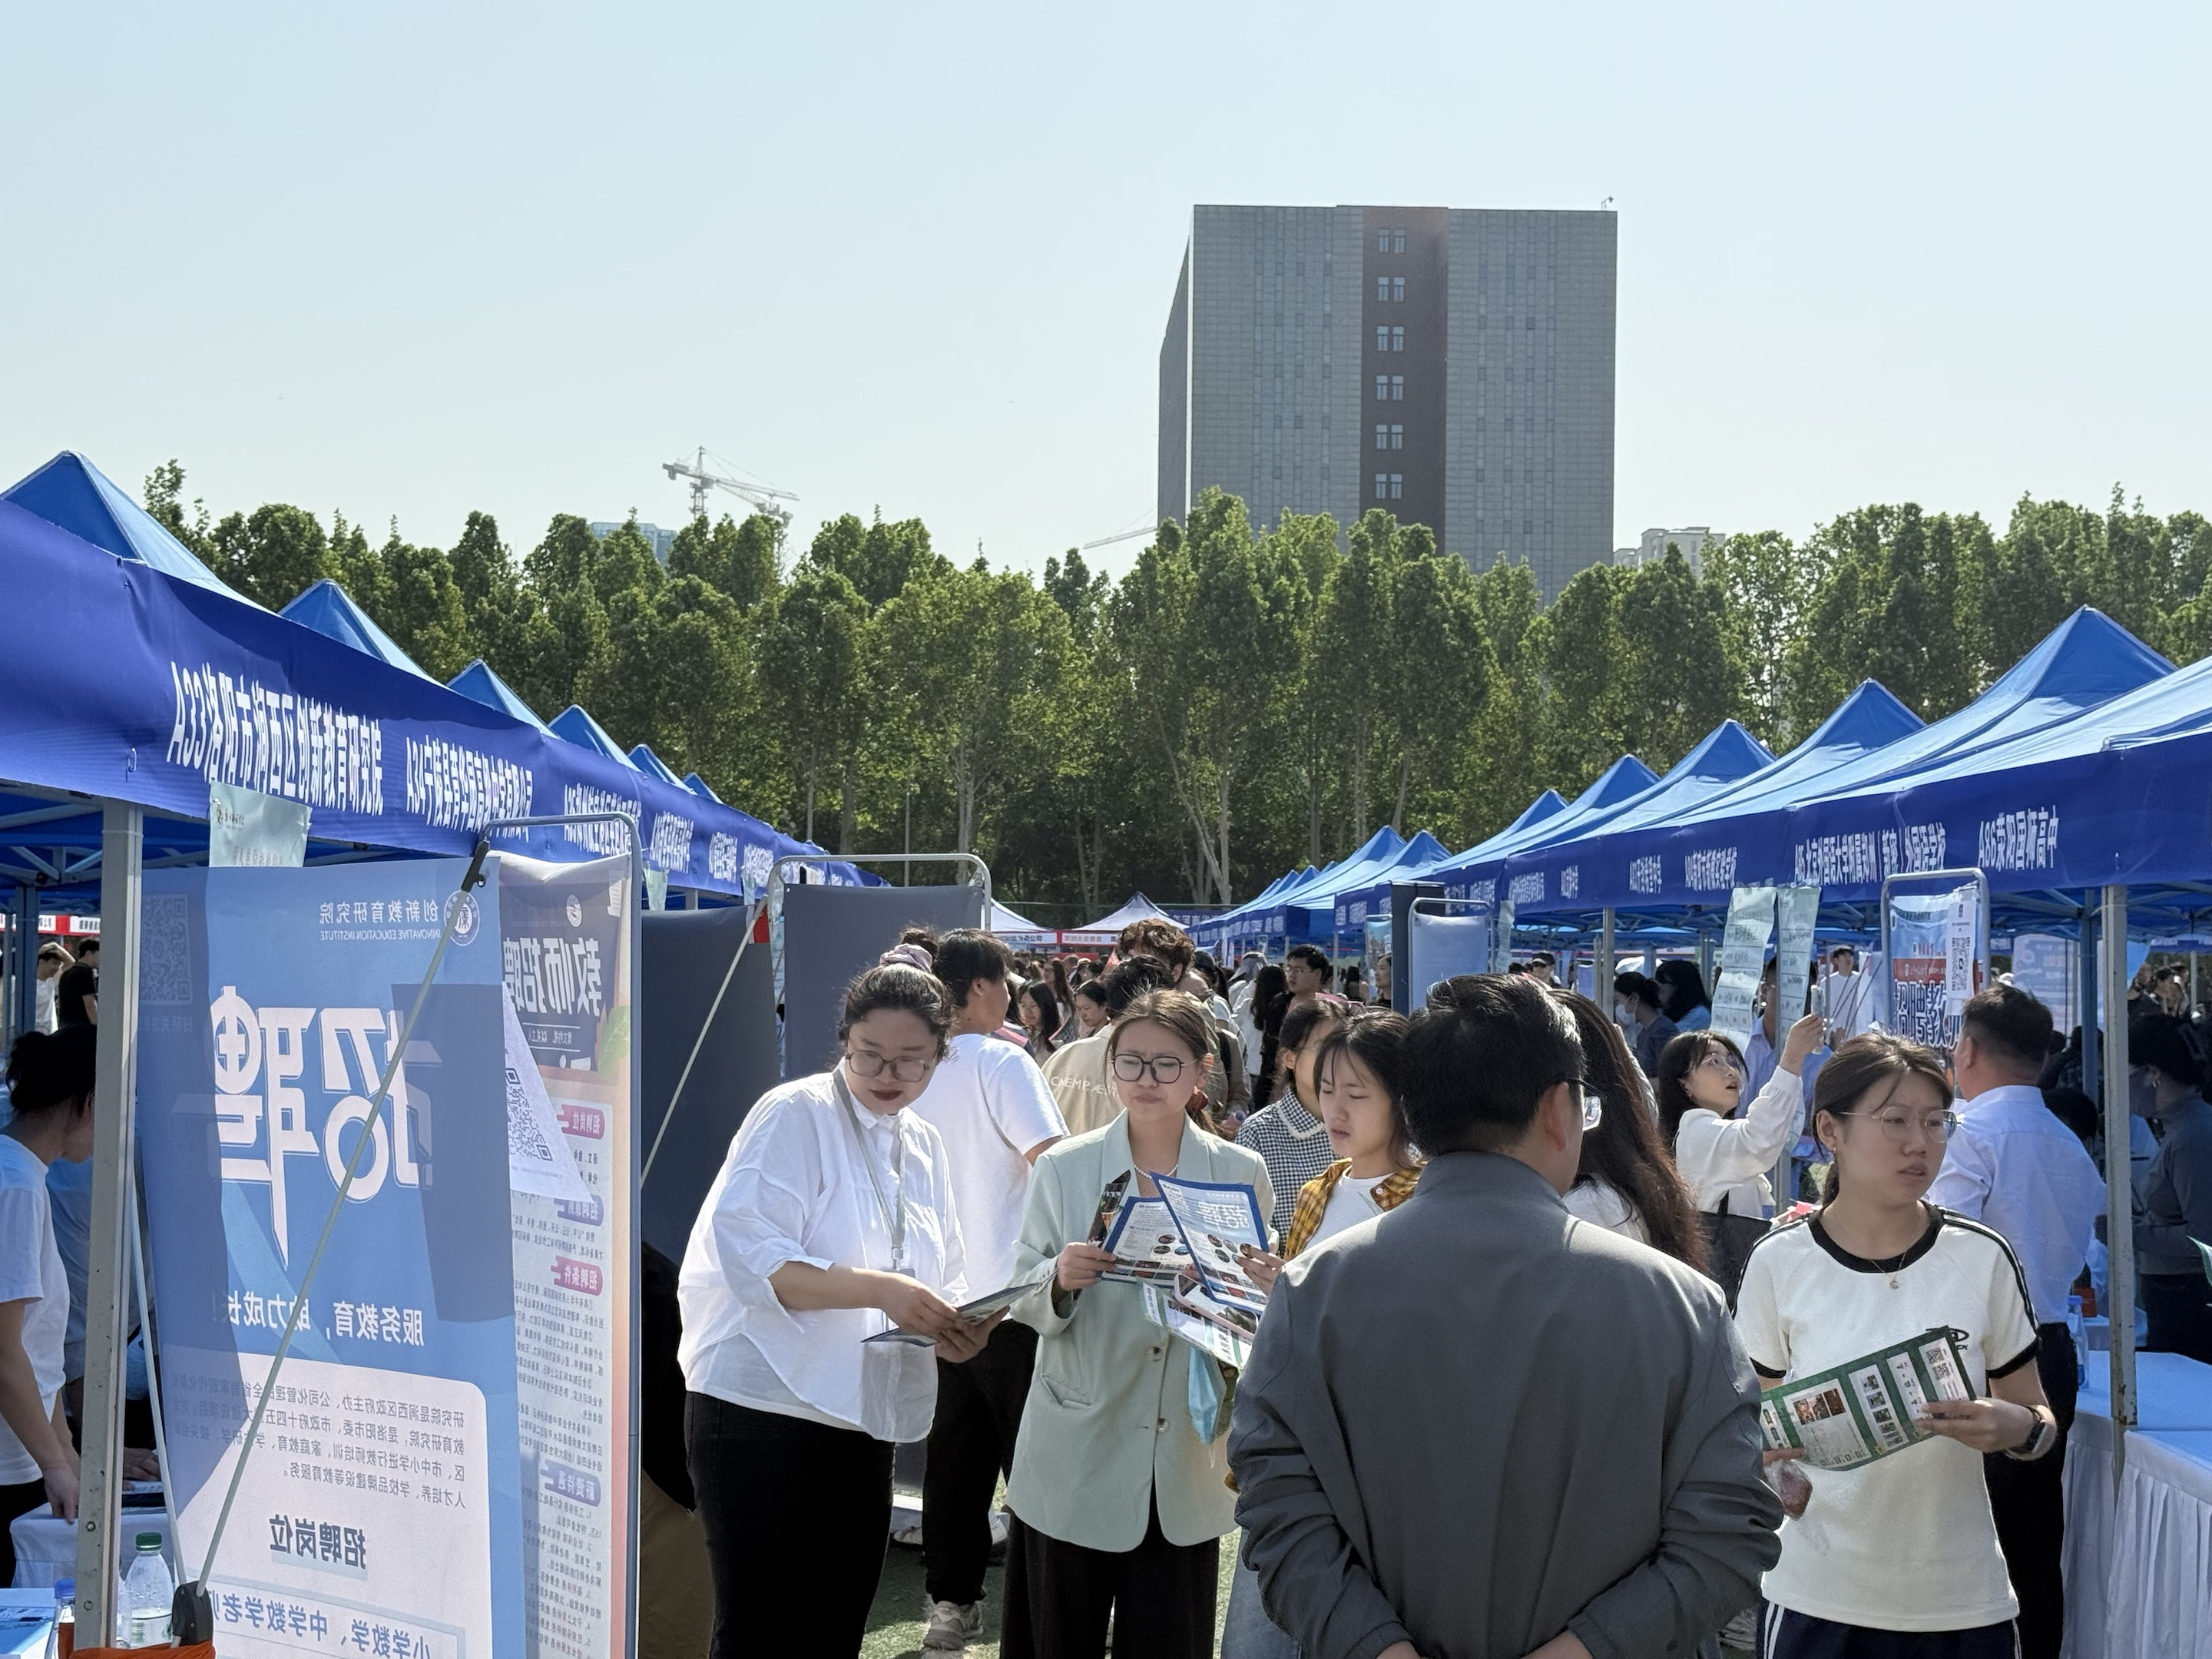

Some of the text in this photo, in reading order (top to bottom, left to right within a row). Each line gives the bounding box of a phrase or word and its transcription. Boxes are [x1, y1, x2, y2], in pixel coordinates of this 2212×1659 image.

[167, 661, 383, 816] A33洛阳市涧西区创新教育研究院
